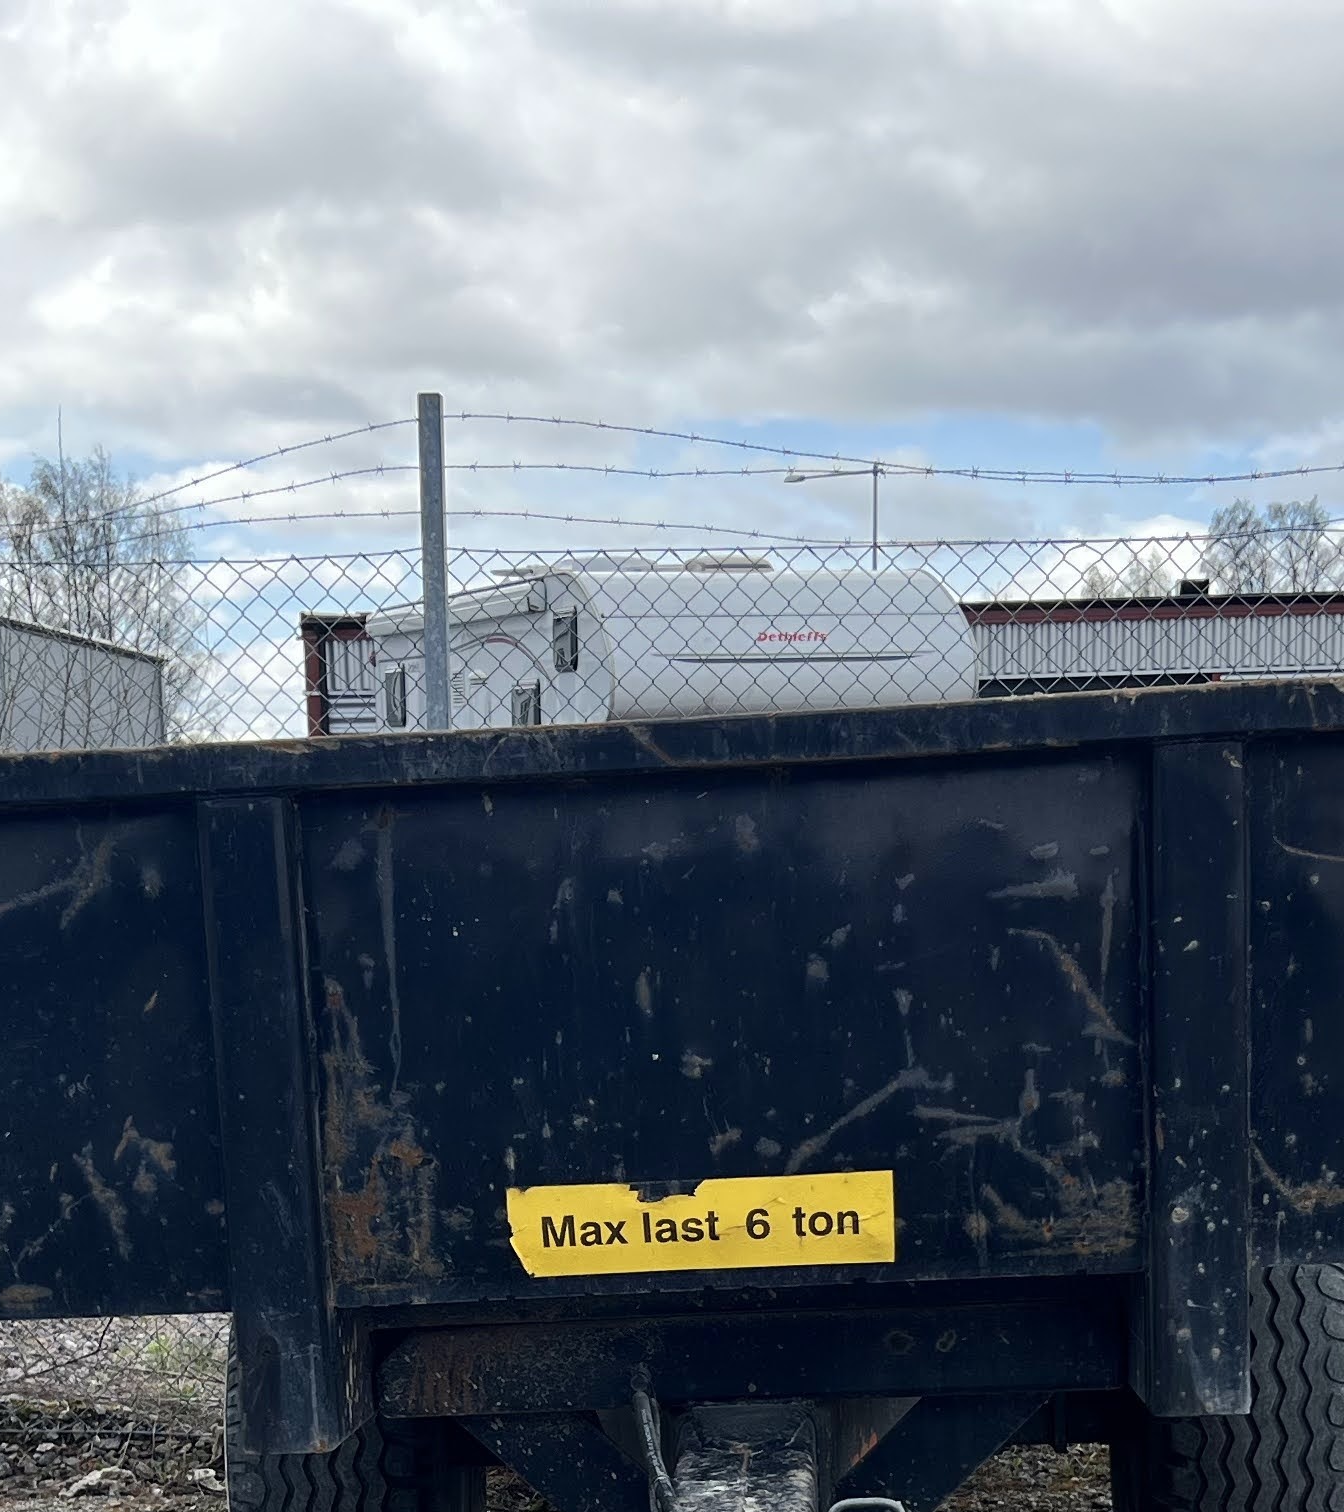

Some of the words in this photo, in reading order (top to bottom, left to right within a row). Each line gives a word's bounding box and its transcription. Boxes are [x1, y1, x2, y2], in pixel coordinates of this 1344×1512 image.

[541, 1214, 629, 1248] Max
[642, 1210, 721, 1244] last
[745, 1208, 771, 1240] 6
[791, 1206, 860, 1237] ton
